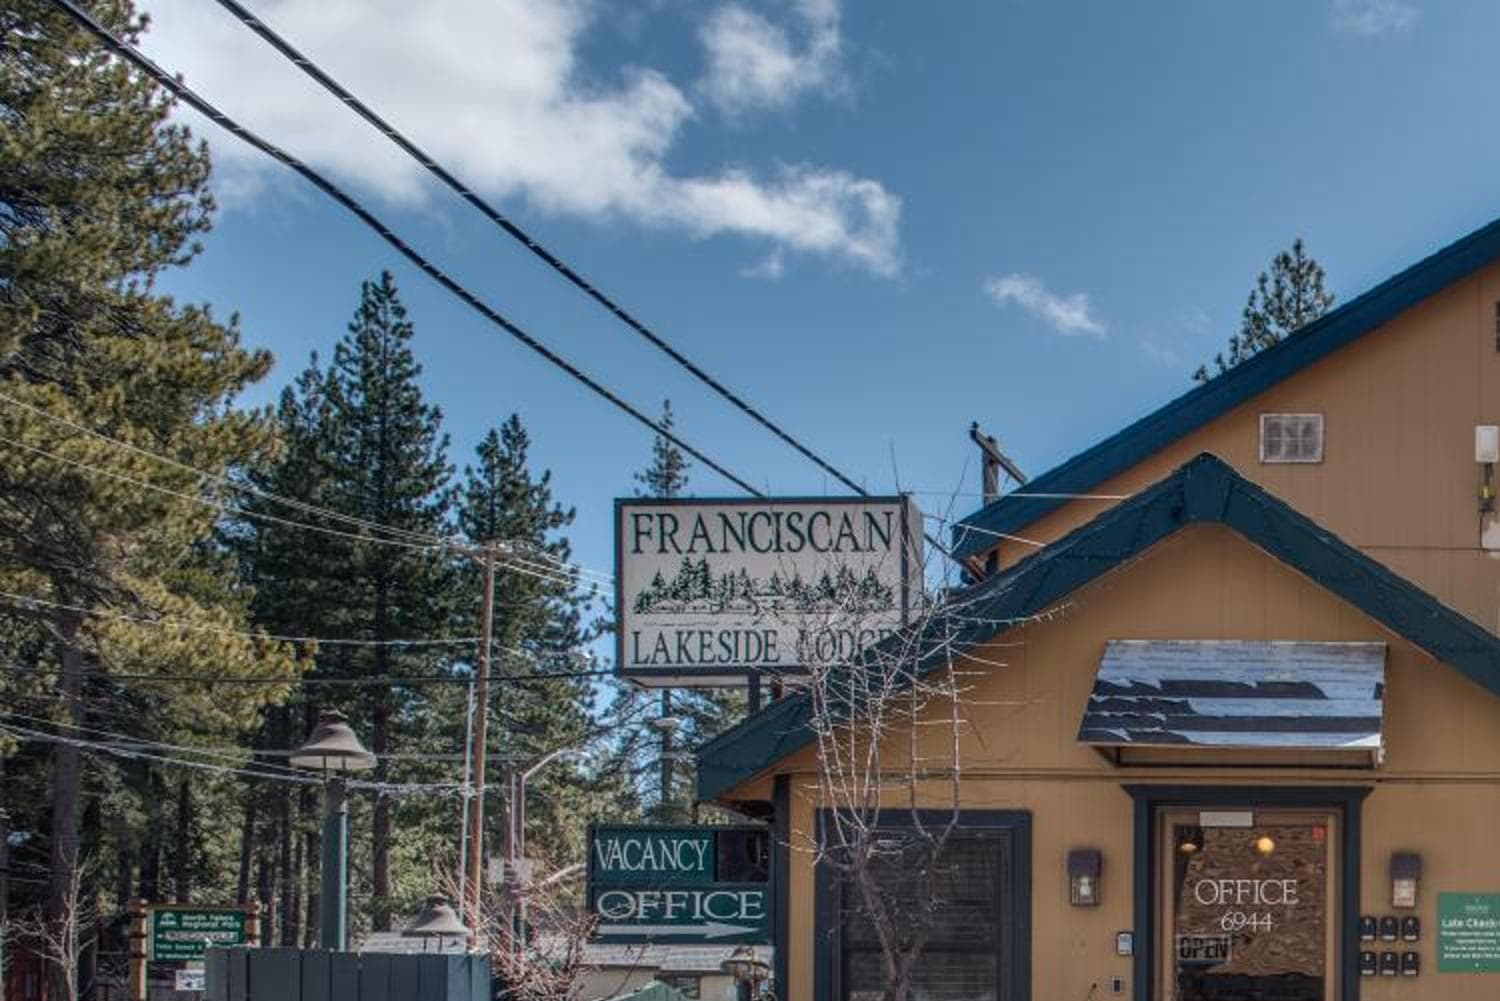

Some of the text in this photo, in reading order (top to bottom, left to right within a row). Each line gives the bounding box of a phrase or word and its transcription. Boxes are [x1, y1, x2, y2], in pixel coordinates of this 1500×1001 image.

[630, 511, 895, 555] FRANCISCAN
[631, 629, 782, 665] LAKESIDE
[595, 837, 709, 872] VACANCY
[597, 890, 767, 920] OFFICE
[1195, 878, 1300, 905] OFFICE
[1220, 911, 1273, 933] 6944
[1180, 936, 1229, 959] OPEN
